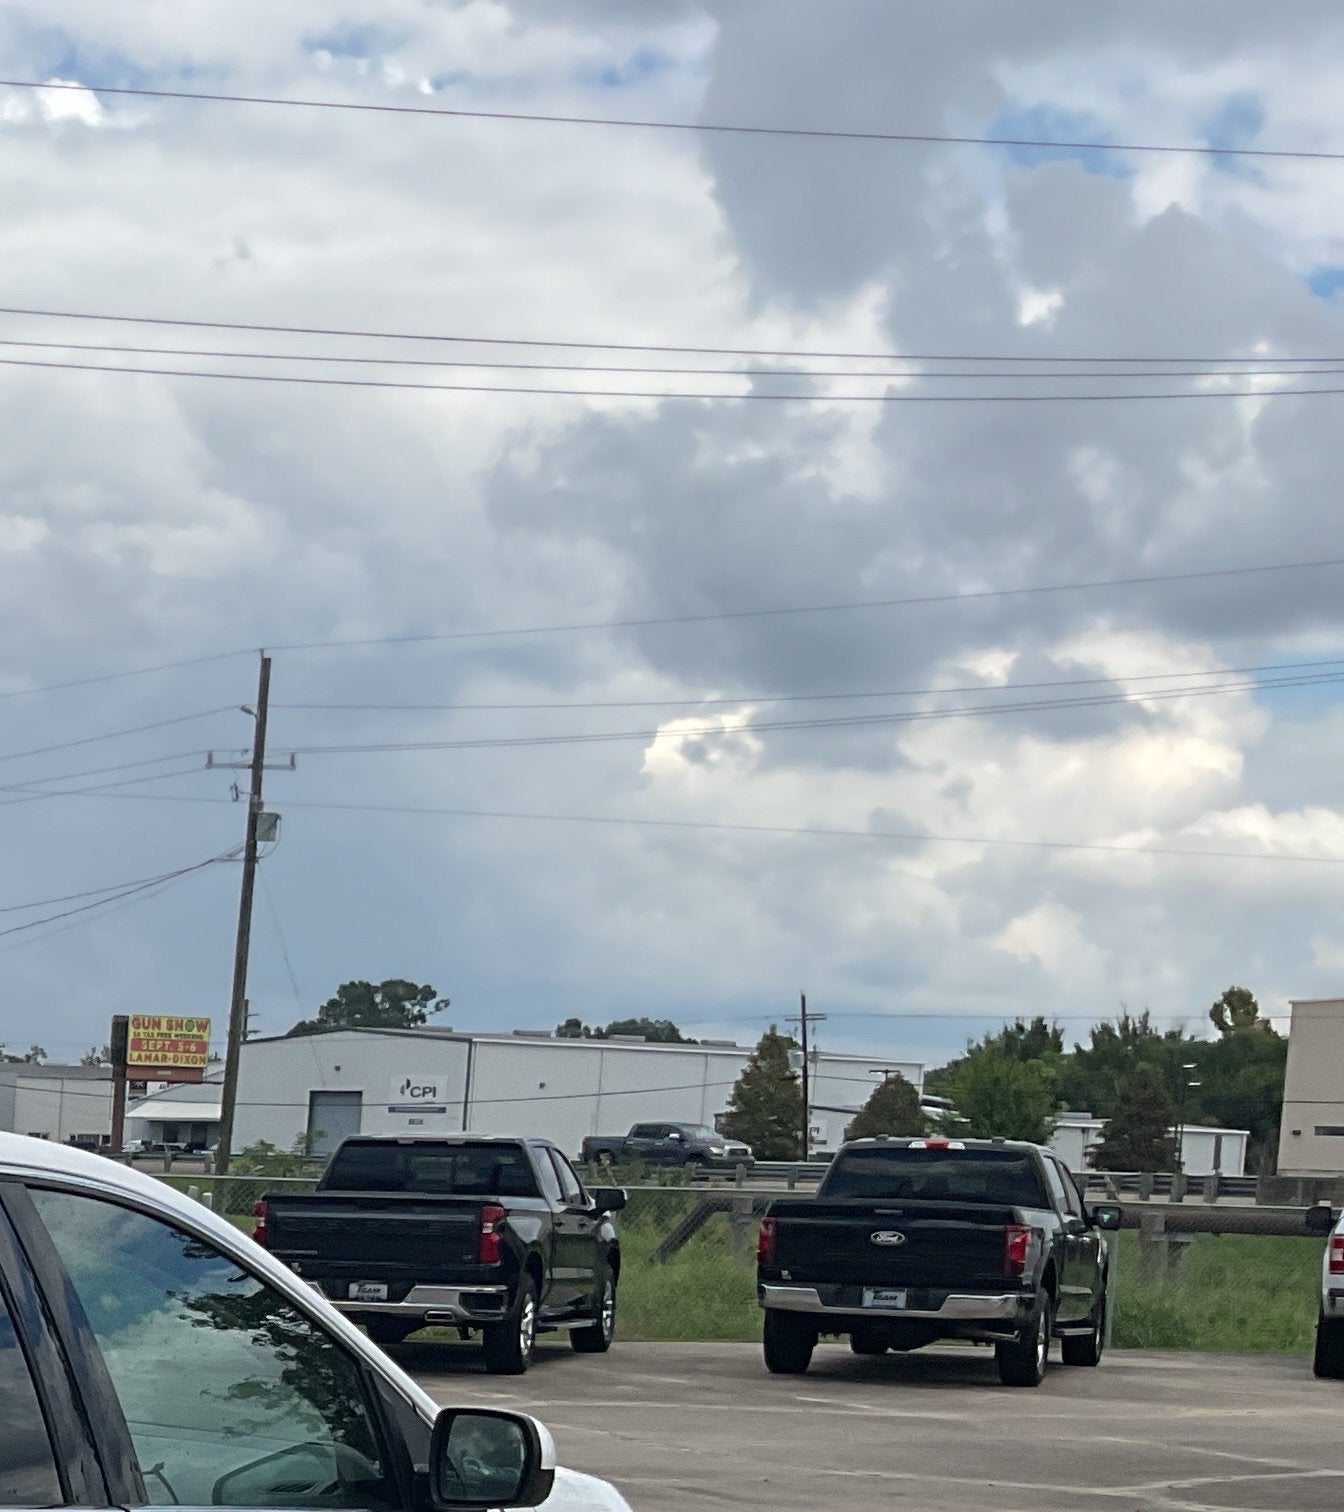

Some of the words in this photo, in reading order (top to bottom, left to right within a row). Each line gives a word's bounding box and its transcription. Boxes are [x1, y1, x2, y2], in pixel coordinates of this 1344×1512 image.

[132, 1017, 162, 1031] GUN
[166, 1018, 209, 1033] SHOW
[177, 1041, 198, 1053] 5-6
[129, 1053, 207, 1065] LAMAR-DIXON
[410, 1086, 437, 1098] CPI
